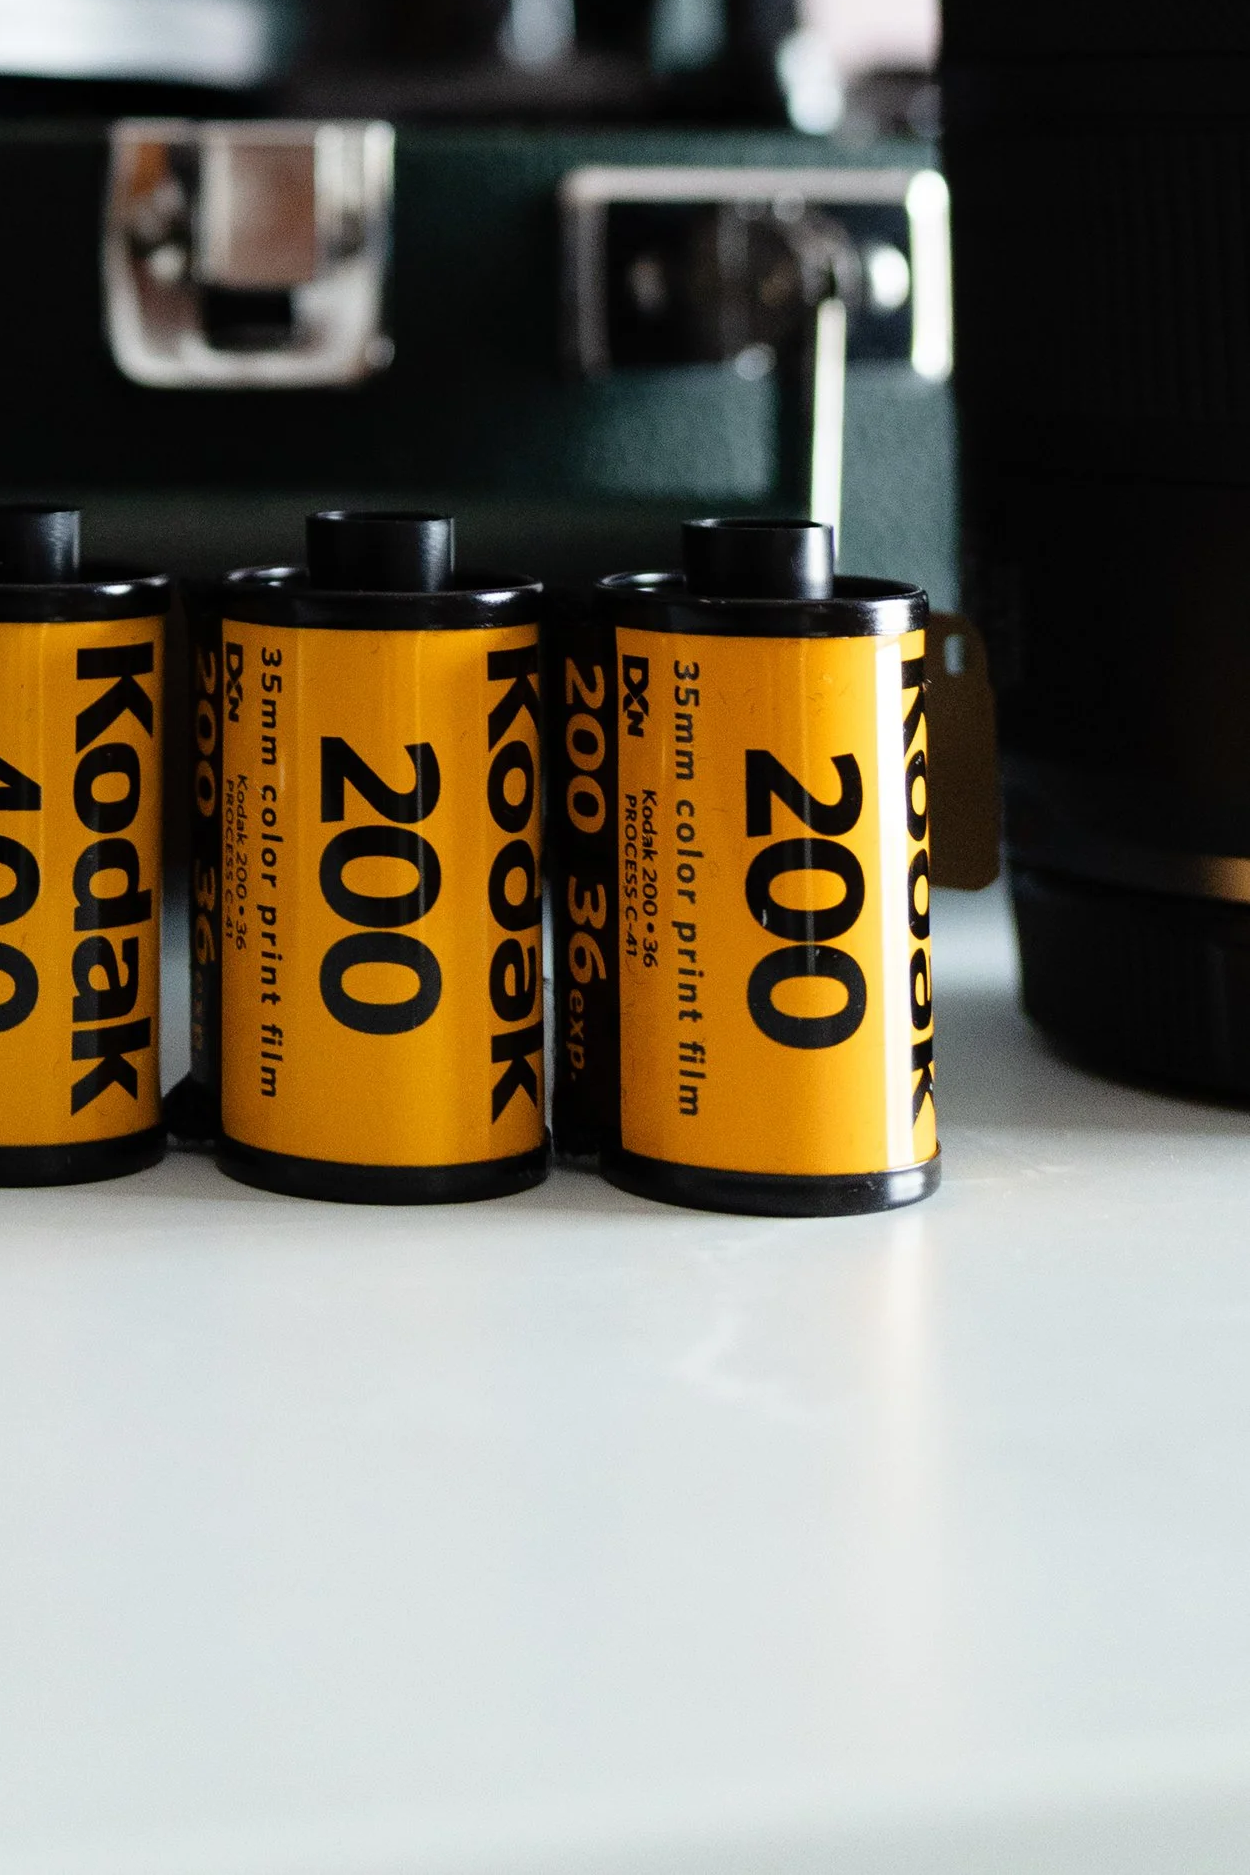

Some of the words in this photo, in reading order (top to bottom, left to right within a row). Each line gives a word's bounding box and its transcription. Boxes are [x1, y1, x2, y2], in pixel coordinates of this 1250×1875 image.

[194, 645, 218, 817] 200
[261, 647, 282, 765] 35mm
[565, 657, 606, 834] 200
[674, 660, 700, 781] 35mm
[224, 779, 234, 882] PROCESS
[235, 774, 249, 845] Kodak
[260, 785, 284, 888] color
[624, 793, 638, 898] PROCESS
[641, 789, 658, 861] Kodak
[676, 799, 704, 903] color
[72, 643, 153, 1116] Kodak
[193, 860, 216, 967] 36
[224, 888, 234, 939] C-41
[235, 851, 248, 899] 200
[320, 736, 442, 1035] 200
[488, 647, 542, 1123] Kodak
[642, 869, 658, 915] 200
[746, 749, 866, 1050] 200
[235, 921, 248, 950] 36
[258, 905, 282, 1005] print
[568, 875, 606, 984] 36
[624, 905, 638, 956] C-41
[642, 939, 658, 967] 36
[672, 921, 705, 1021] print
[260, 1023, 282, 1098] film
[678, 1040, 705, 1117] film
